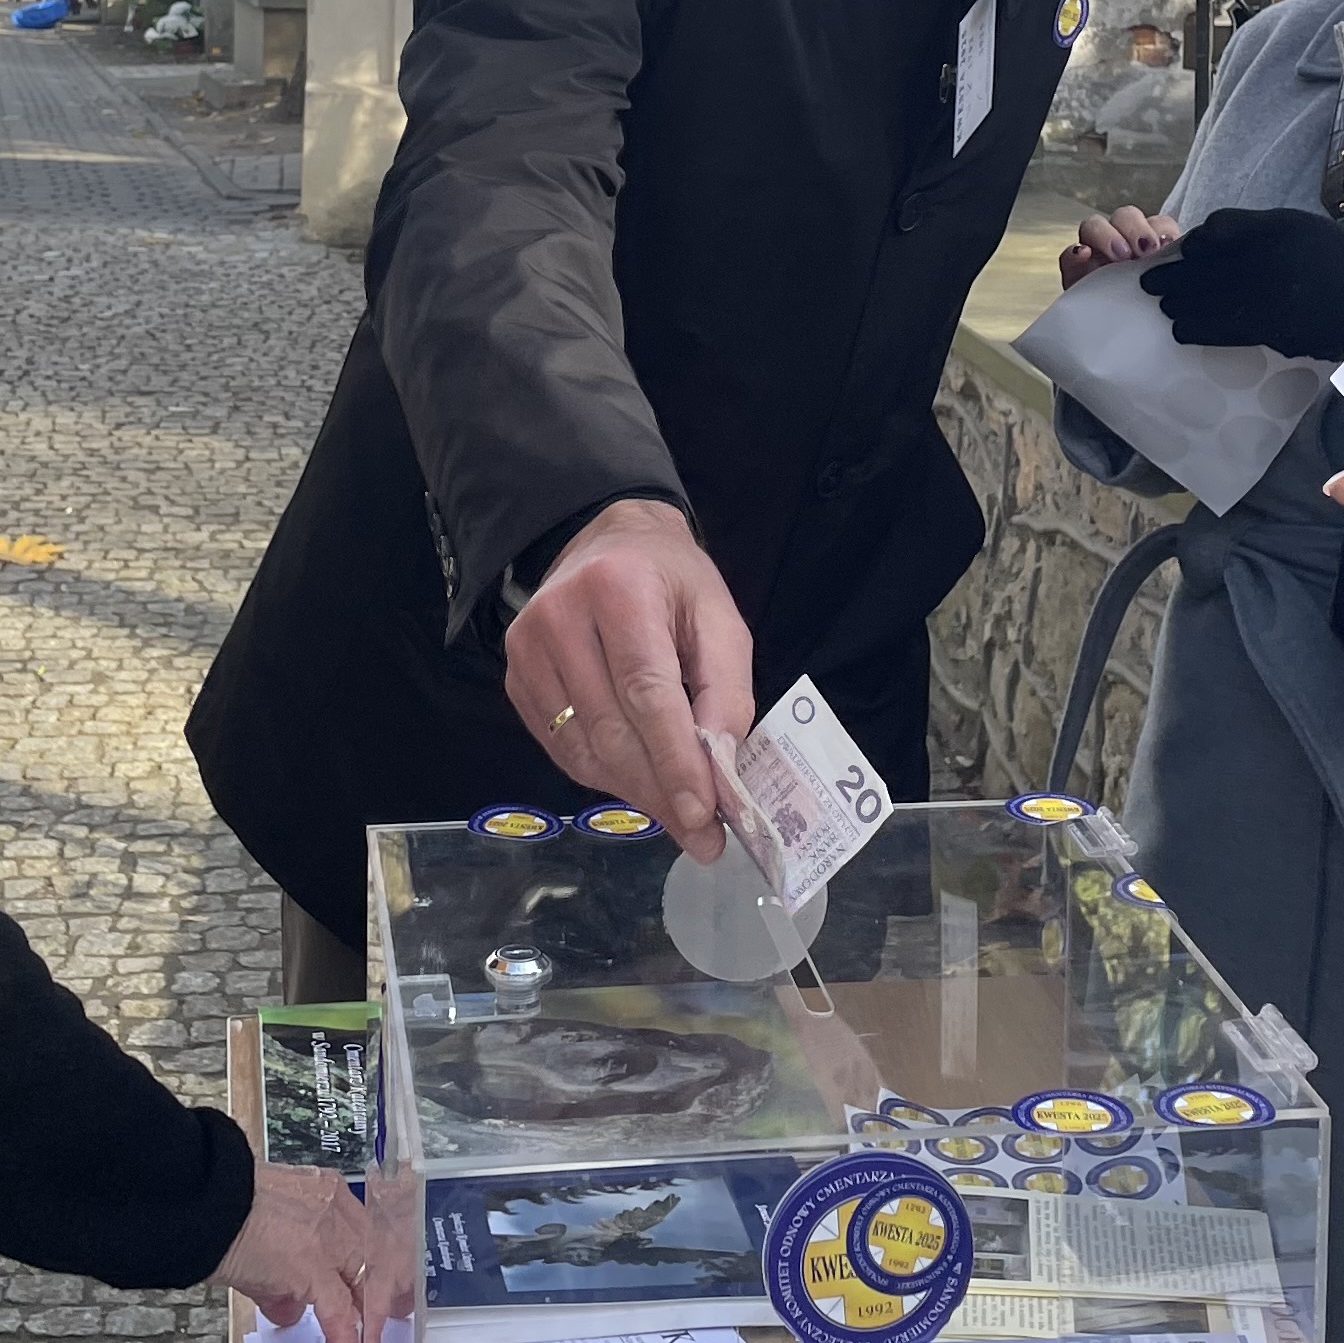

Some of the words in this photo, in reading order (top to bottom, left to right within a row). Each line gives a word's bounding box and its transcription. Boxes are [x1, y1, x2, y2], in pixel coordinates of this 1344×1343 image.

[836, 764, 882, 824] 20
[317, 1097, 338, 1119] 1792
[1036, 1111, 1081, 1121] KWESTA
[1182, 1105, 1223, 1117] KWESTA
[320, 1129, 342, 1153] 2017
[816, 1169, 896, 1202] CMENTARZA
[780, 1198, 814, 1257] ODNOWY
[872, 1220, 913, 1245] KWESTA
[915, 1231, 941, 1252] 2025
[777, 1259, 803, 1319] KOMITET
[858, 1301, 894, 1319] 1992
